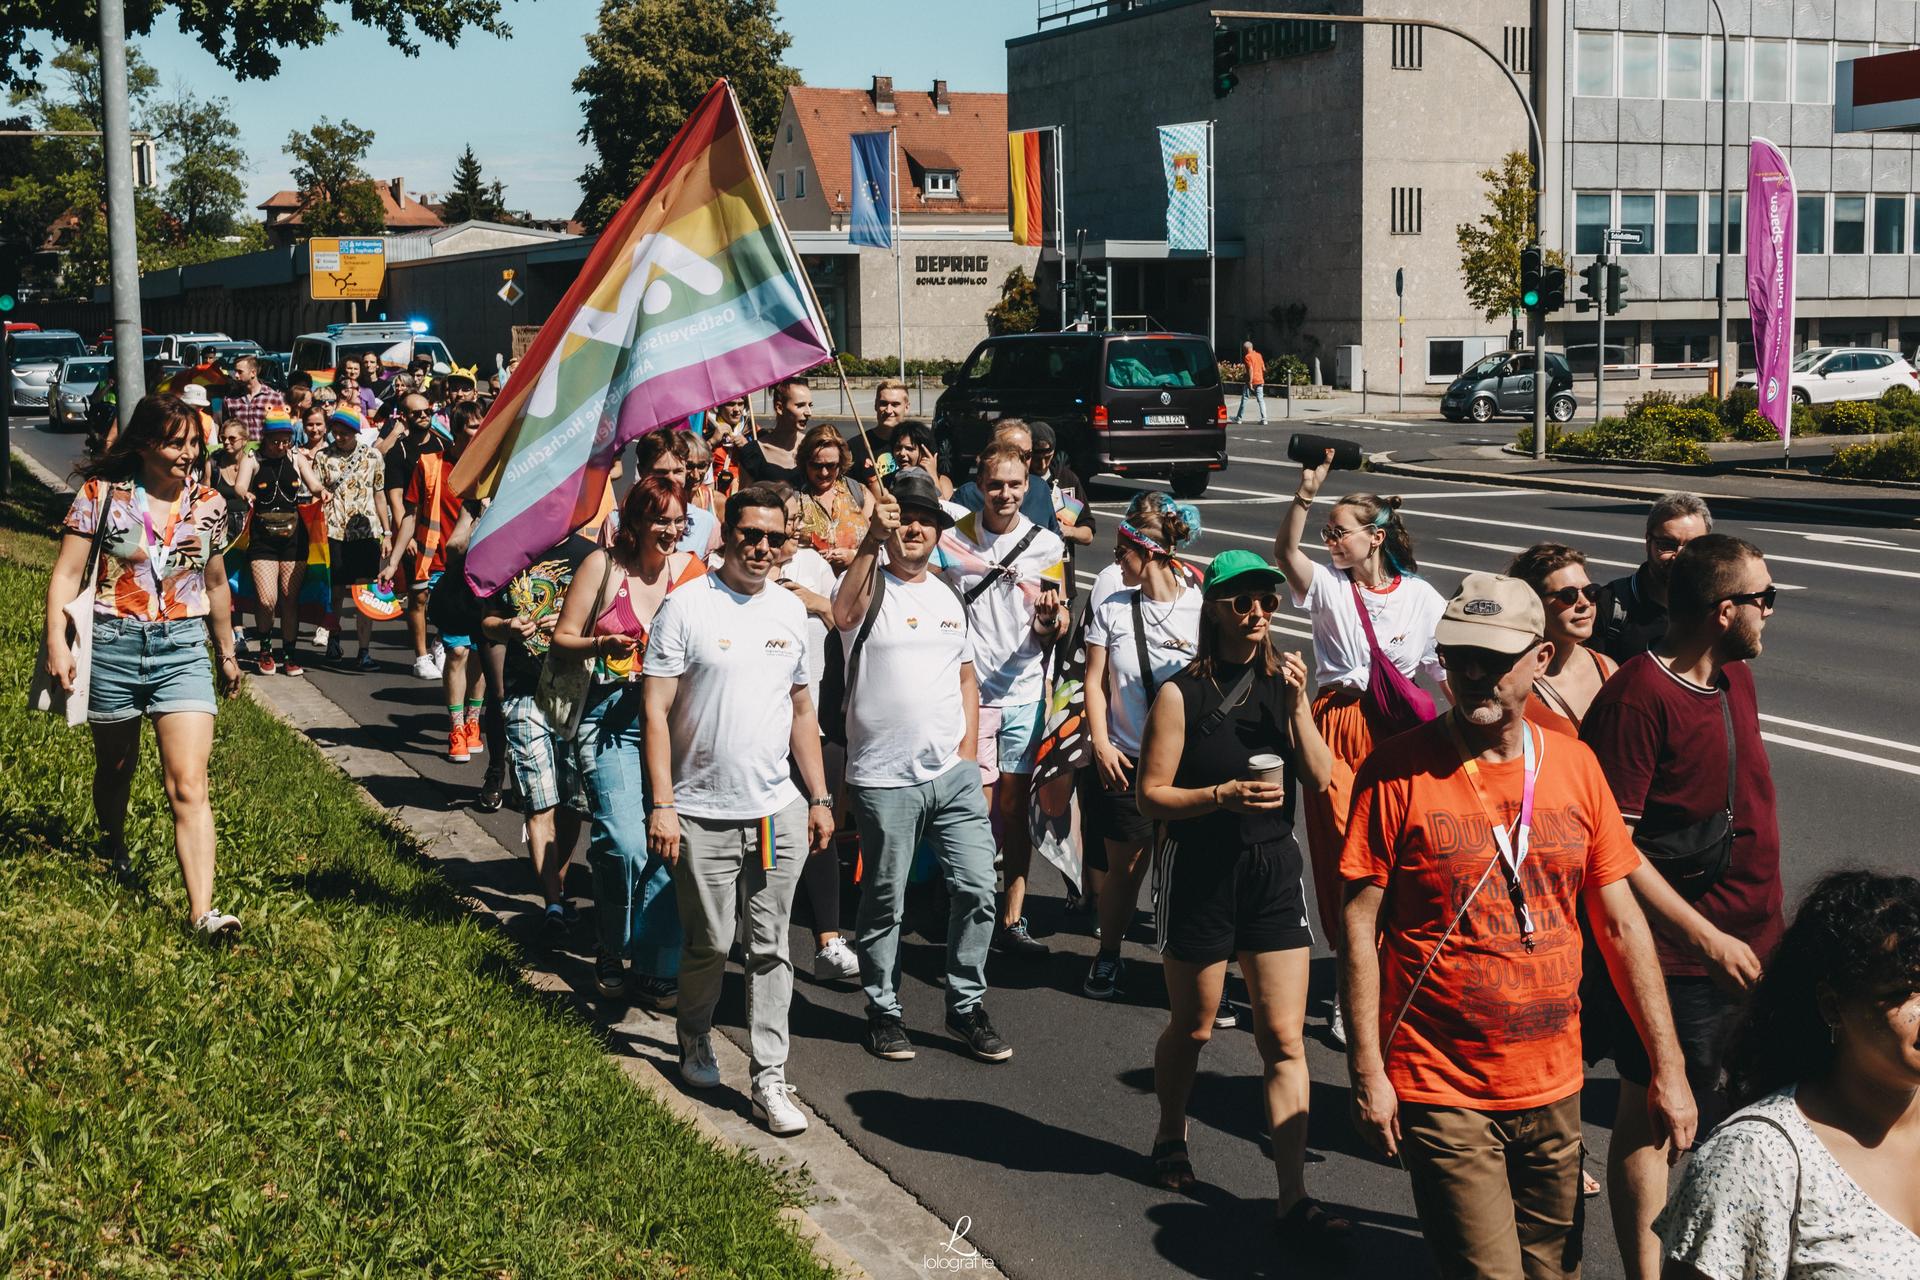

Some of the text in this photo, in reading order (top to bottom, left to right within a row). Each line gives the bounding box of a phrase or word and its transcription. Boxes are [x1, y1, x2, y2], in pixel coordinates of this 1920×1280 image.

[1236, 20, 1337, 65] EPRAG
[1770, 192, 1784, 244] Sparen.
[916, 256, 988, 272] DEPRAG
[916, 277, 946, 286] SCHULZ
[1775, 247, 1785, 309] Punkten.
[1463, 957, 1539, 990] SOUR
